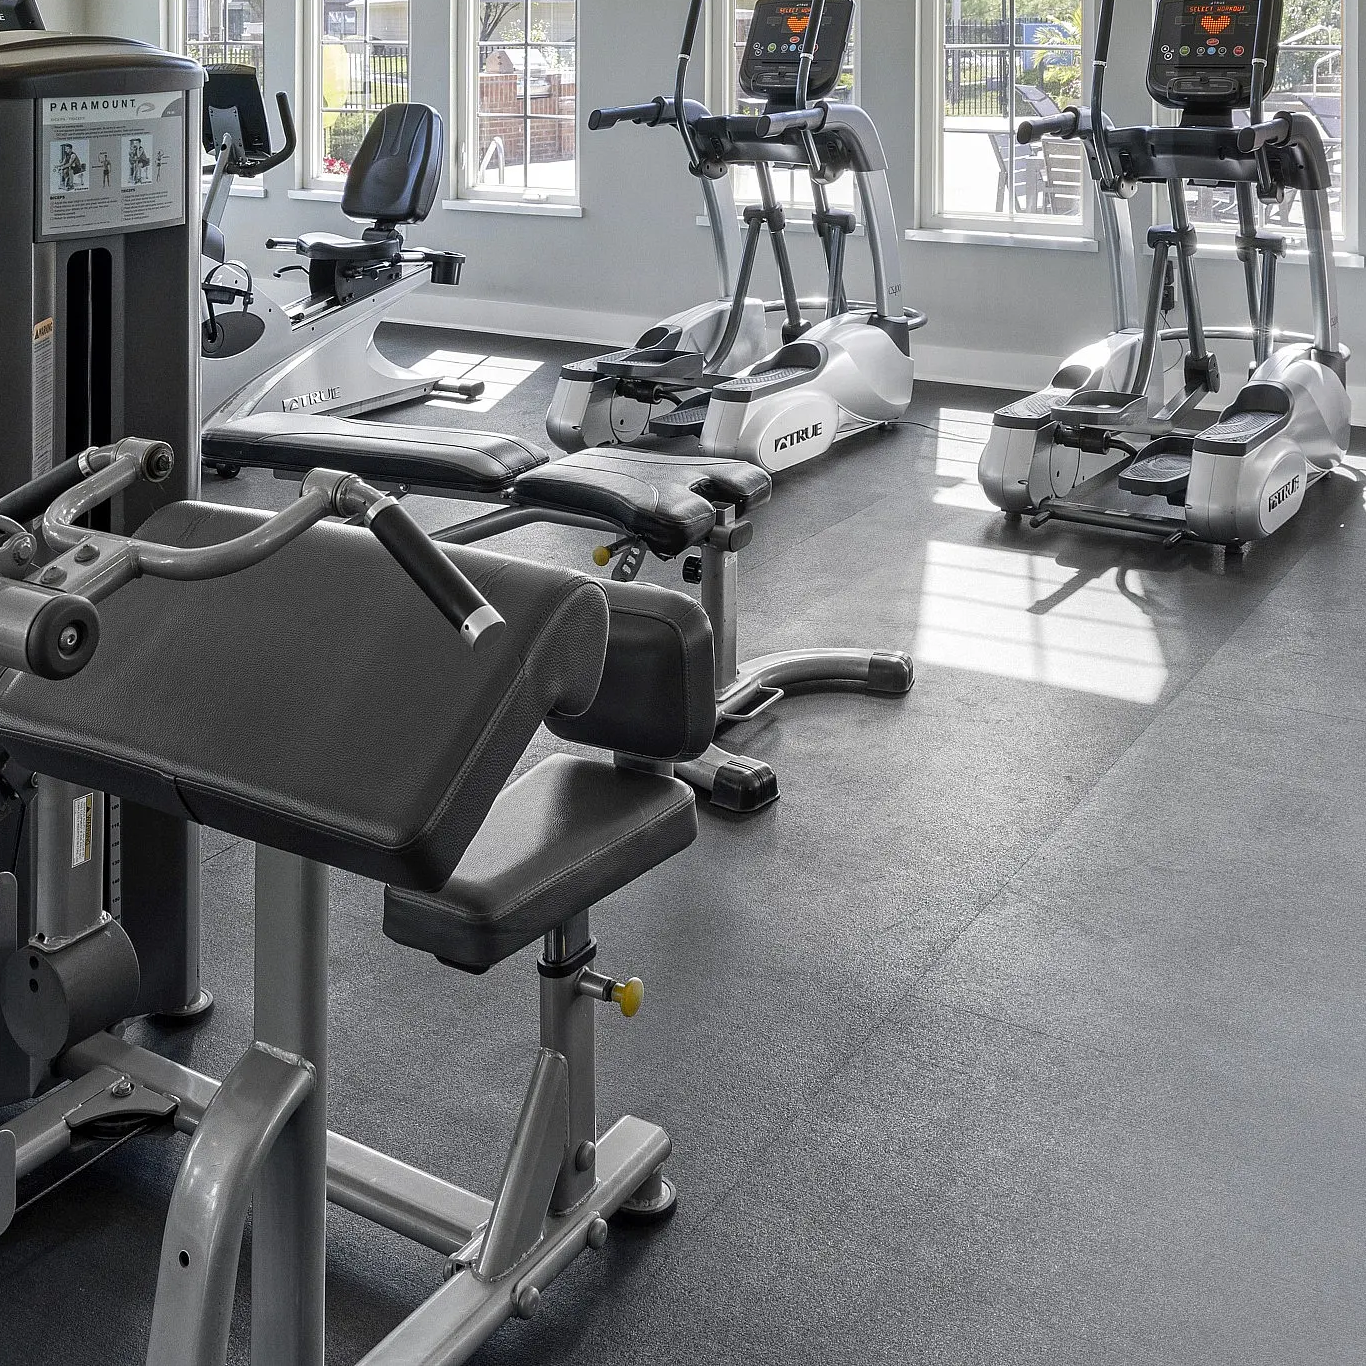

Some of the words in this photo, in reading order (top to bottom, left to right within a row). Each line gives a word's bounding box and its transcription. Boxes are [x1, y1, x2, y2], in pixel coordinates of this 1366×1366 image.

[50, 99, 136, 112] PARAMOUNT
[299, 386, 341, 407] TRUE
[788, 422, 822, 446] TRUE
[1277, 474, 1299, 504] TRUE
